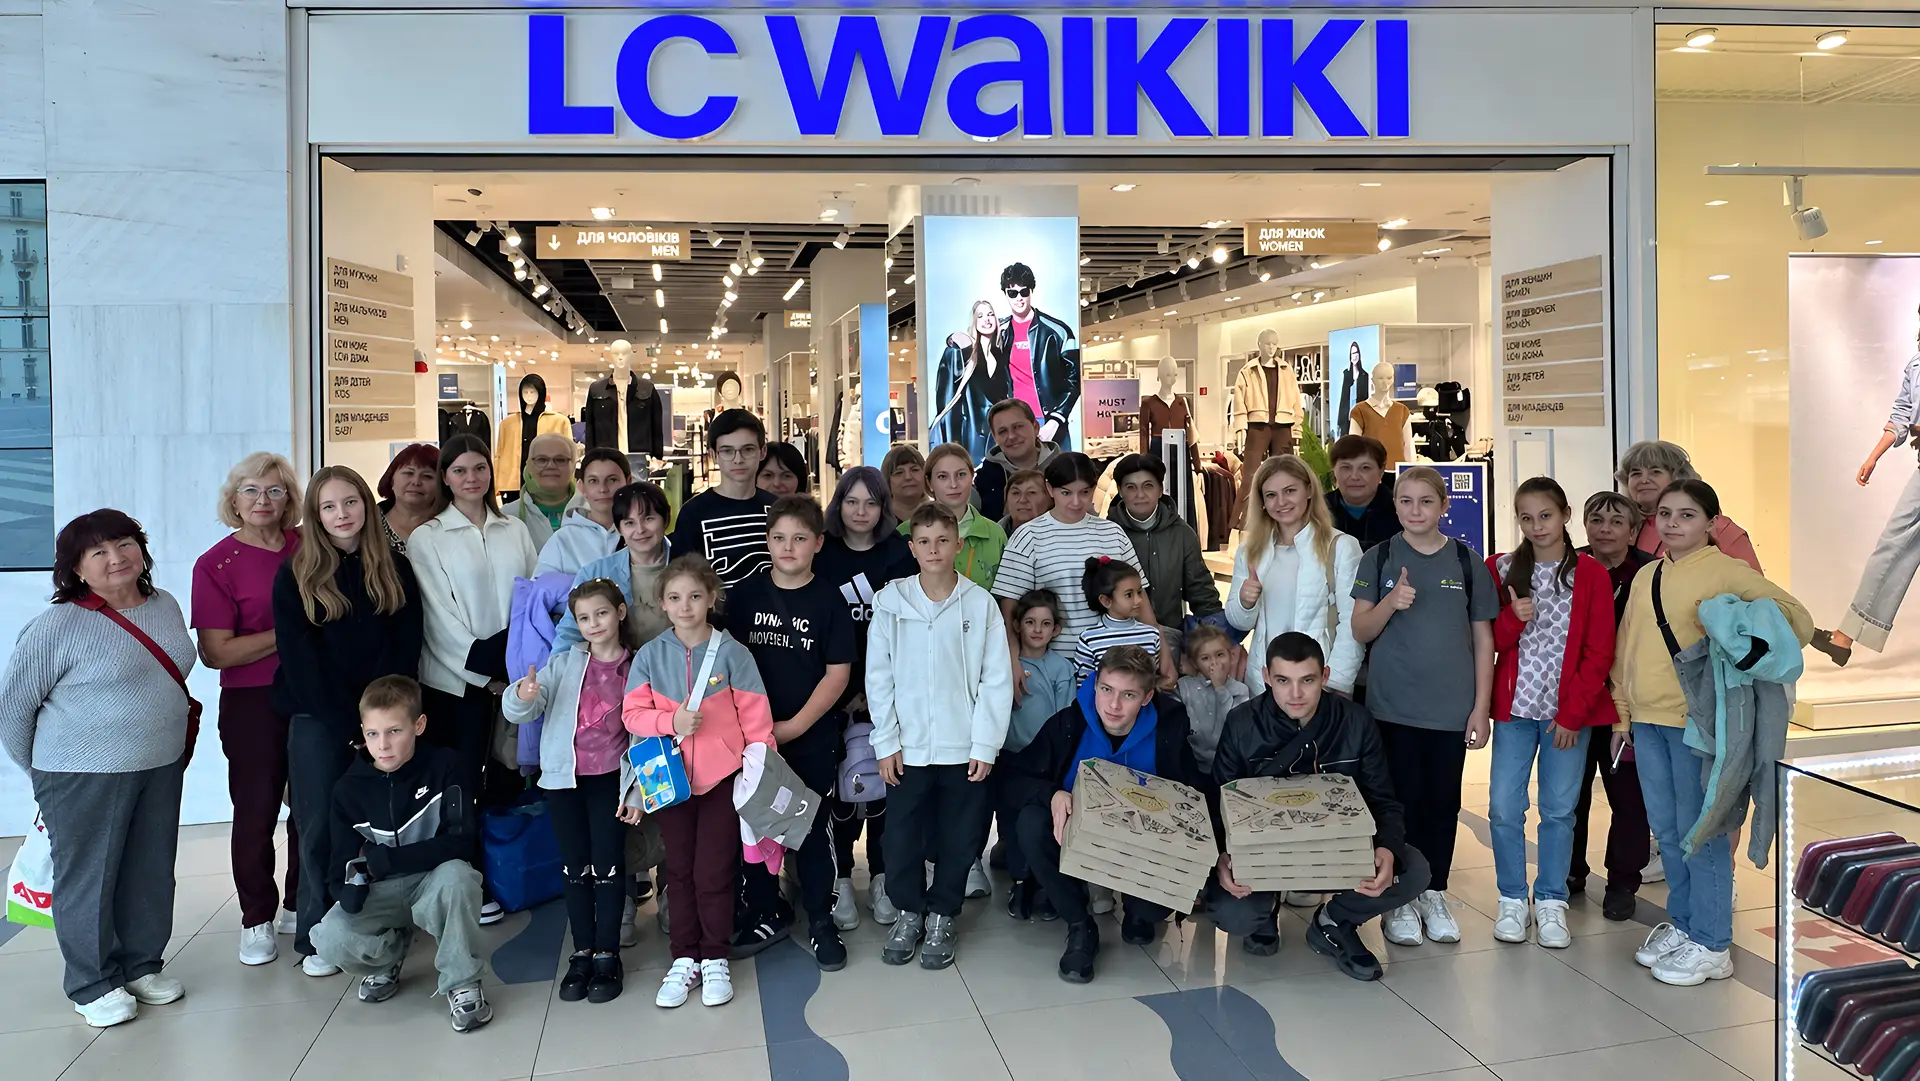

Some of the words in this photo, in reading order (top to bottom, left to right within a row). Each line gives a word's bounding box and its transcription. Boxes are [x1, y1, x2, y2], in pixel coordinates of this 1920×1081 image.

[529, 15, 739, 140] LC
[577, 231, 605, 245] ДЛЯ
[608, 231, 680, 244] ЧОЛОВІКІВ
[1259, 228, 1284, 240] ДЛЯ
[1286, 228, 1326, 239] ЖІНОК
[652, 245, 680, 257] MEN
[1259, 241, 1304, 252] WOMEN
[1098, 398, 1126, 407] MUST
